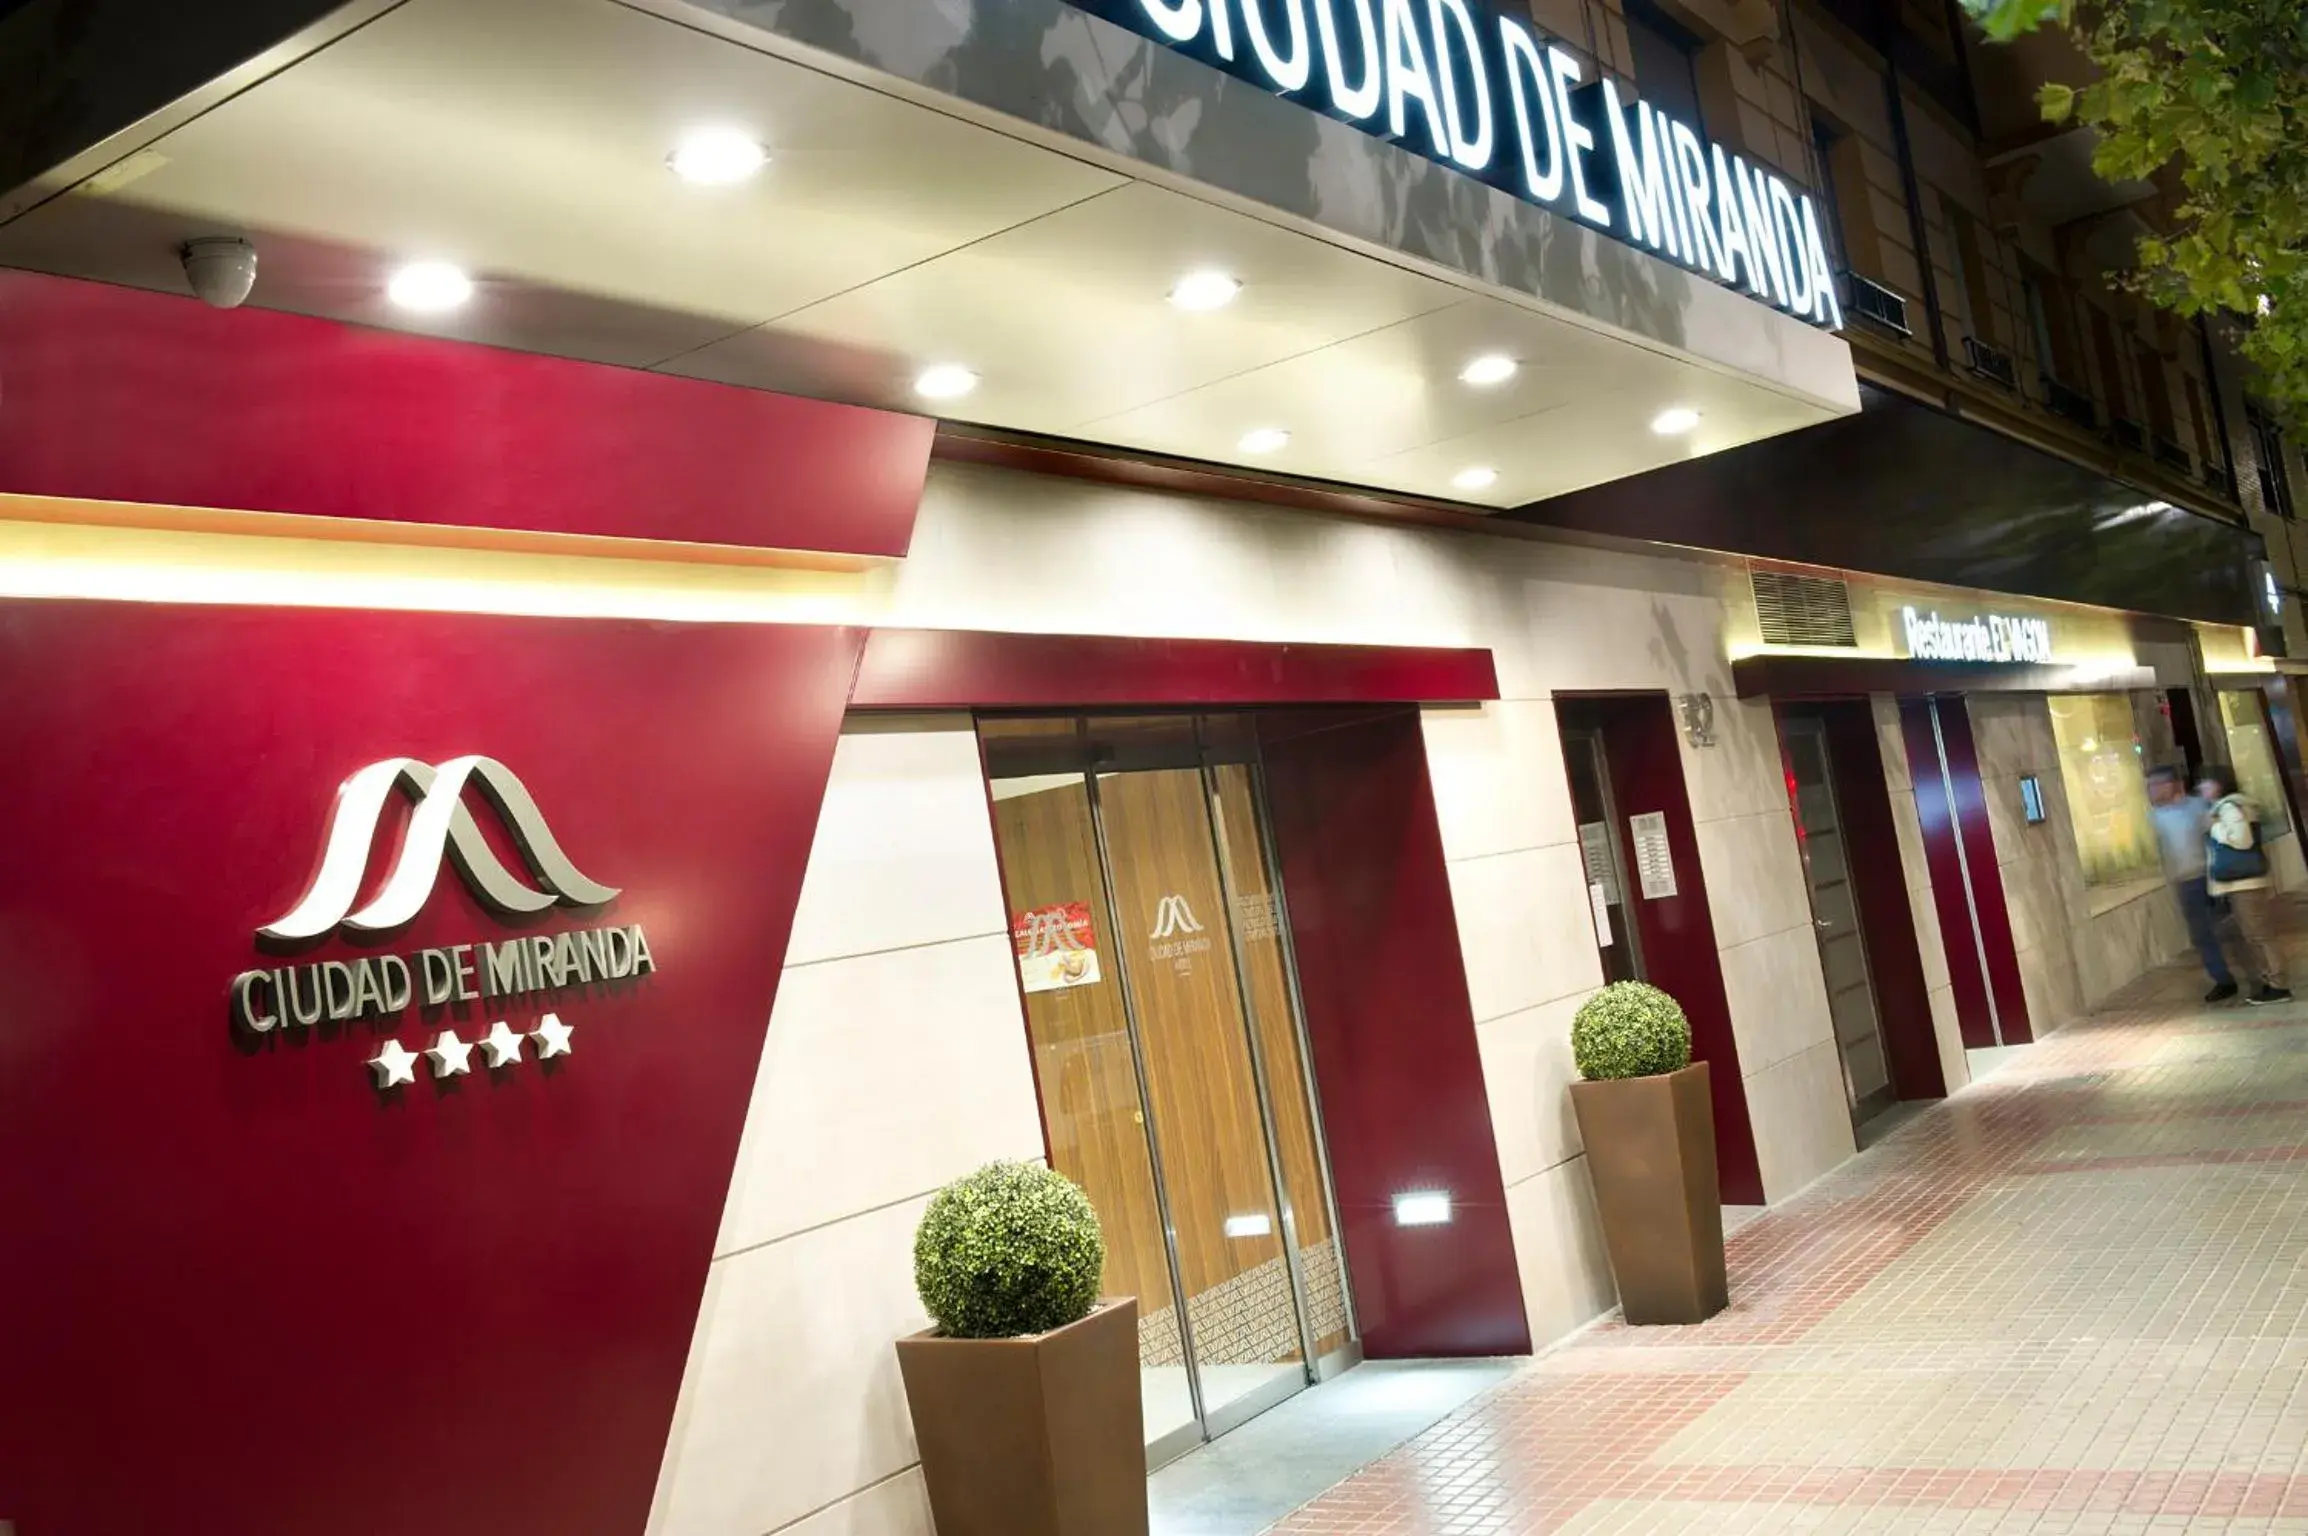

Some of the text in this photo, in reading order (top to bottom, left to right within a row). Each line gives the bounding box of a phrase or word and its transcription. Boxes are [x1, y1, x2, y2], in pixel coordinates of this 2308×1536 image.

[1139, 0, 1843, 330] DAD DE MIRANDA
[242, 924, 657, 1032] CIUDAD DE MIRANDA
